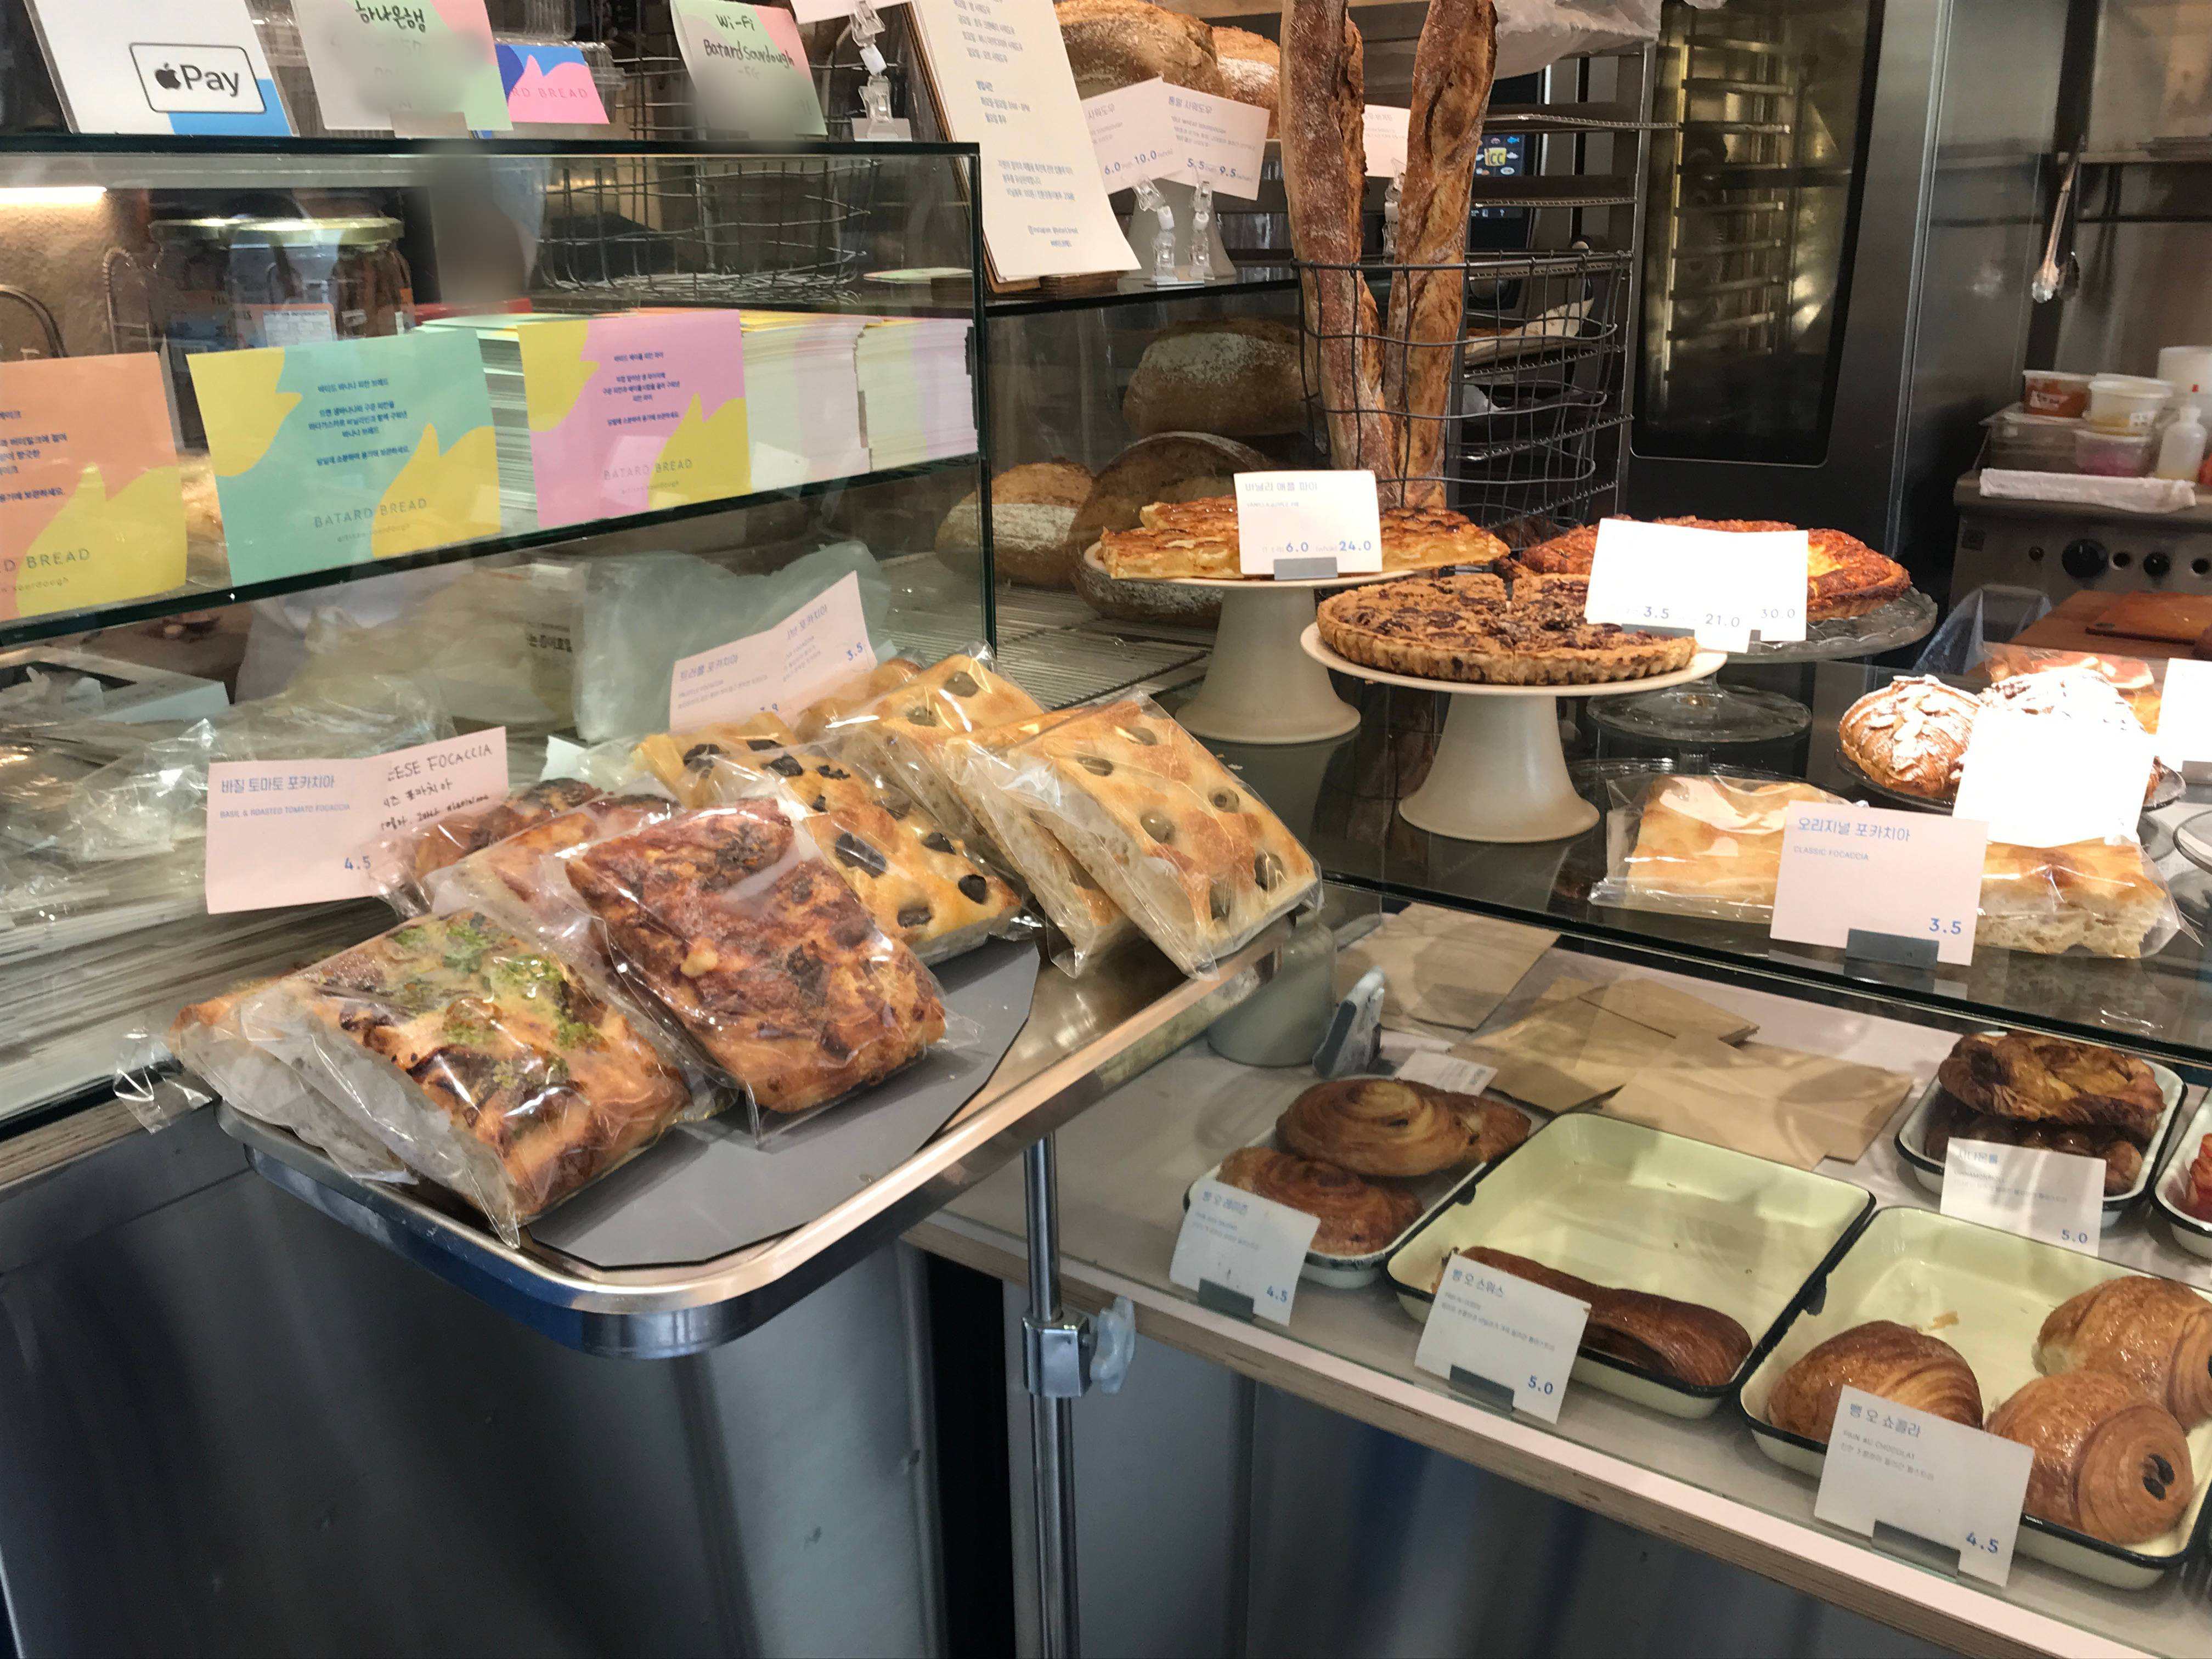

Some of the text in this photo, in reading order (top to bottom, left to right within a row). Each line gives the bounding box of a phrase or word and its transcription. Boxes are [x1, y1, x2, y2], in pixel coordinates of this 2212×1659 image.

[355, 1, 426, 32] 하나은행
[716, 14, 754, 30] Wi-Fi
[180, 64, 240, 97] Pay
[538, 87, 588, 99] BREAD
[1104, 162, 1121, 176] 6.0
[1134, 150, 1158, 166] 10.0
[314, 498, 427, 528] BATARD BREAD
[1286, 541, 1309, 553] 6.0
[1339, 540, 1372, 552] 24.0
[26, 549, 91, 570] BREAD
[1643, 606, 1670, 619] 3.5
[1706, 613, 1741, 628] 21.0
[1760, 608, 1796, 619] 30.0
[427, 743, 493, 771] FOCACCIA
[222, 775, 335, 794] 바질 토마토 포카치아
[1798, 816, 1911, 842] 오리지널 포카치아
[1793, 845, 1870, 861] CLASSIC FOCACCIA
[344, 855, 371, 871] 4.5
[1928, 917, 1962, 936] 3.5
[2061, 1228, 2088, 1244] 5.0
[1266, 1285, 1288, 1304] 4.5
[1528, 1374, 1554, 1395] 5.0
[1966, 1531, 1999, 1555] 4.5
